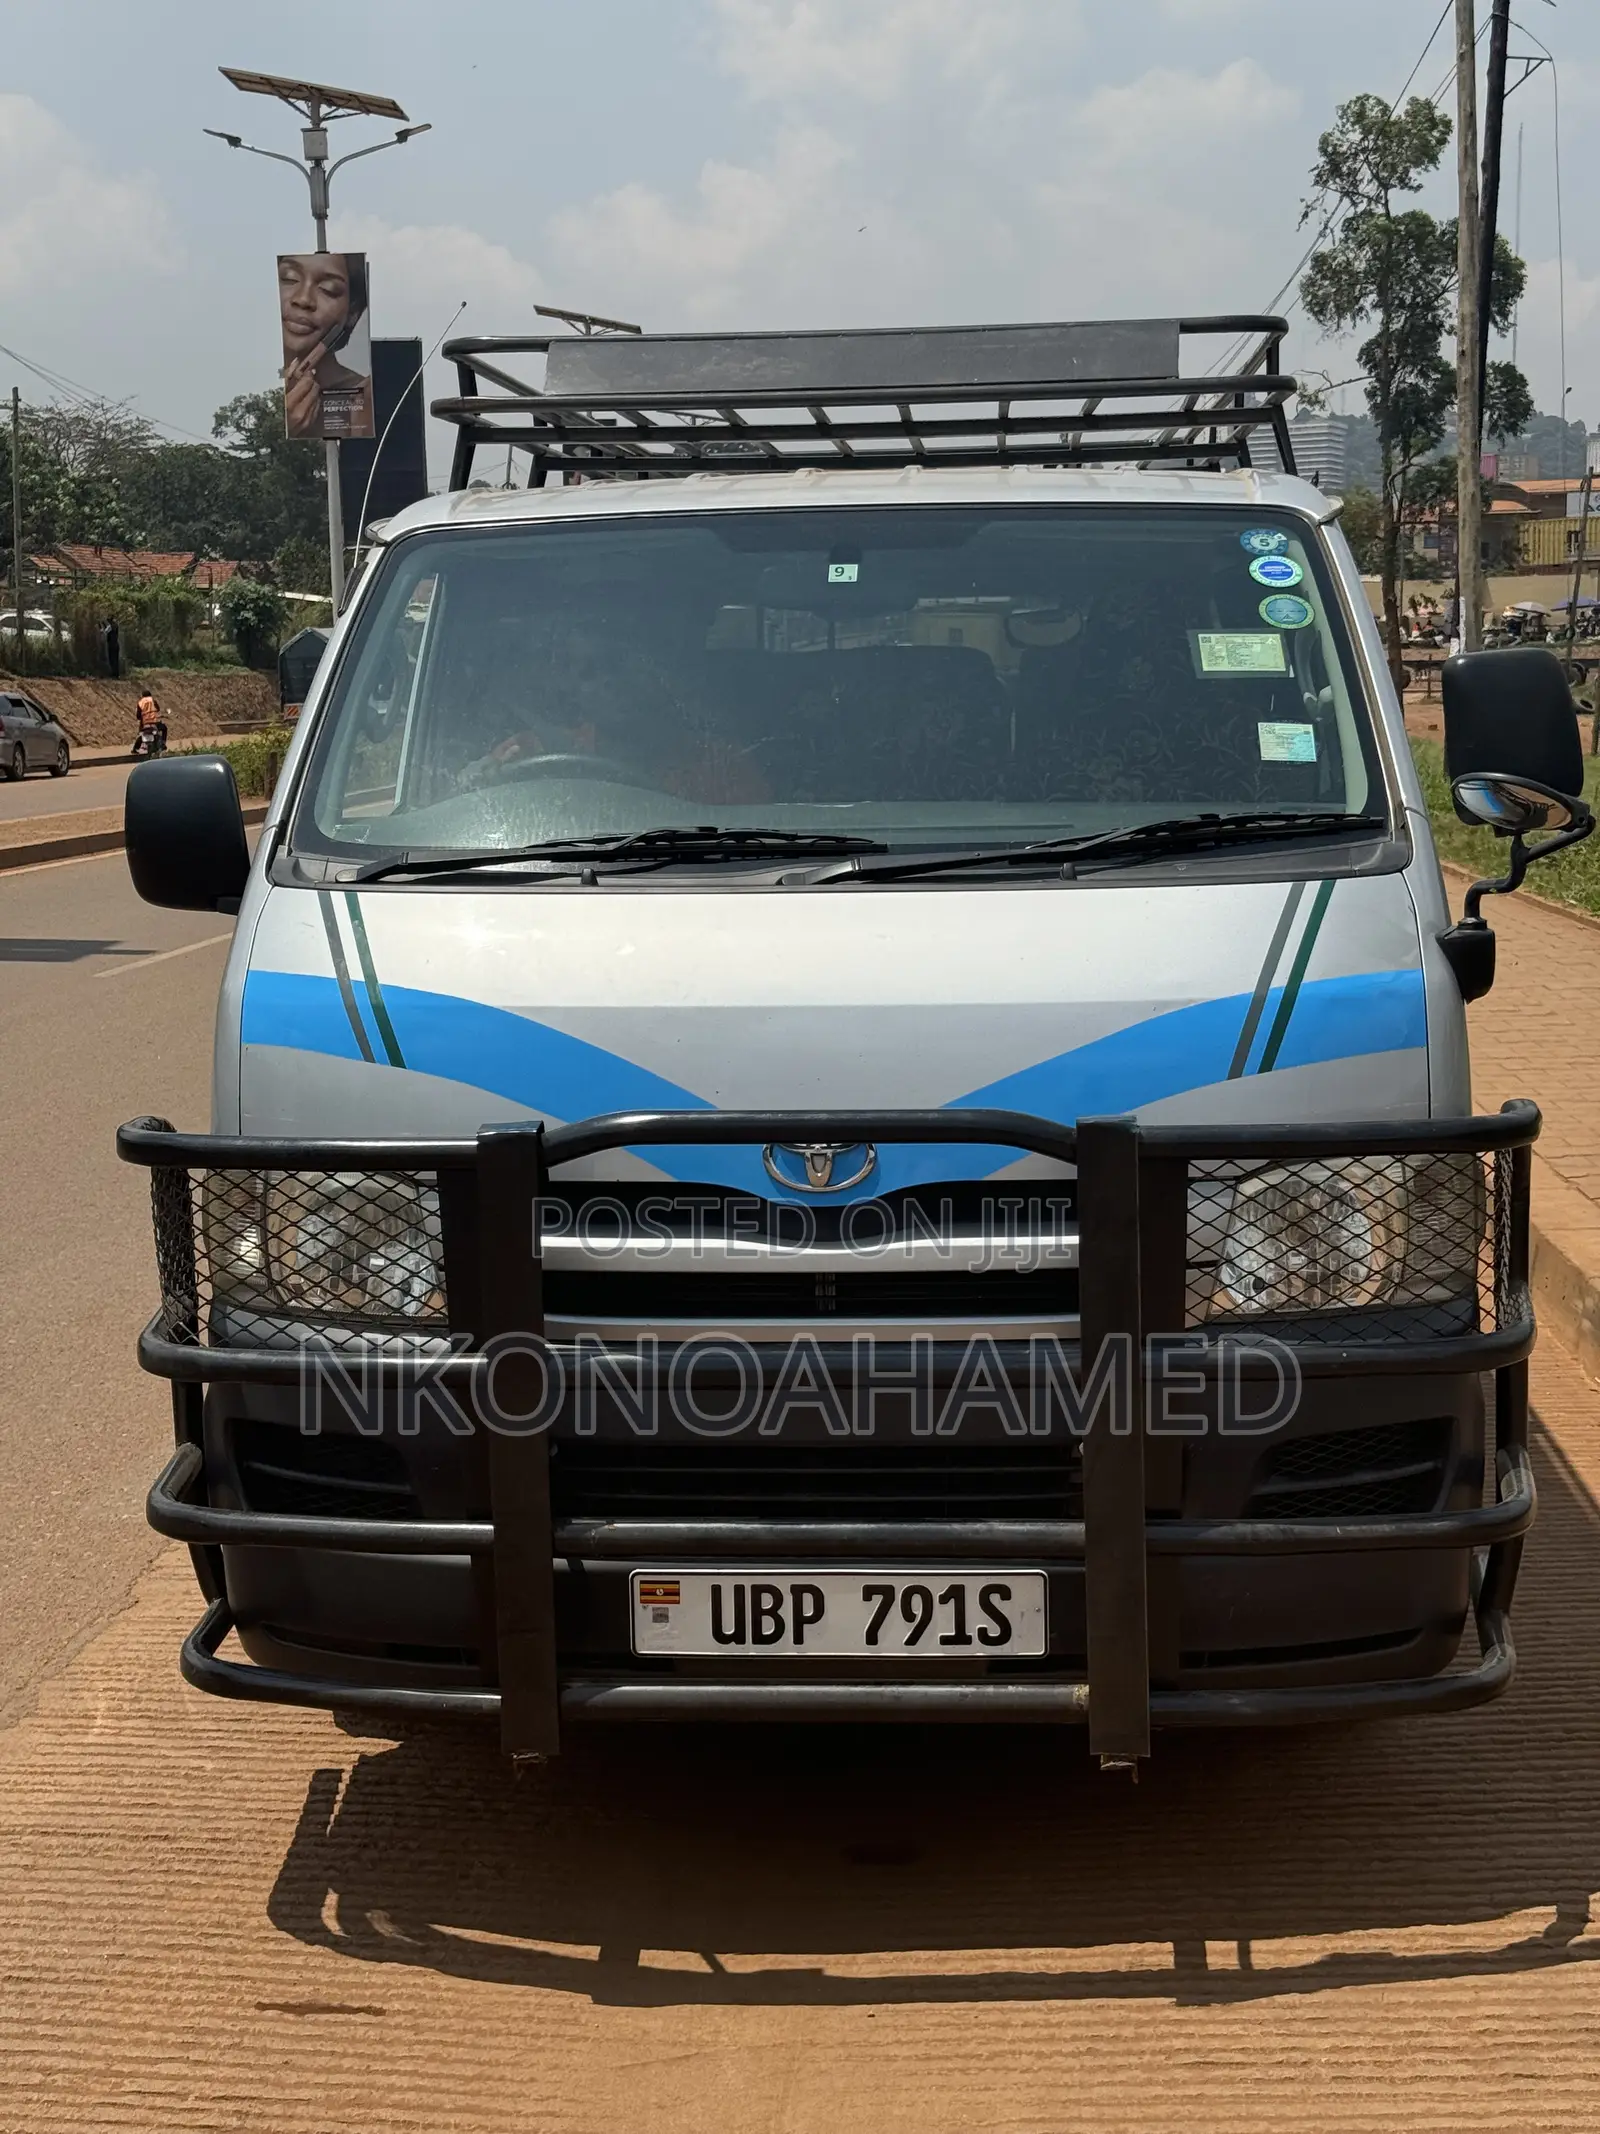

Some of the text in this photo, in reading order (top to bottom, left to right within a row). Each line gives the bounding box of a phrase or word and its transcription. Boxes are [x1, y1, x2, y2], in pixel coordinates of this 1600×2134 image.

[834, 566, 845, 577] 9
[710, 1583, 1013, 1647] UBP 791S
